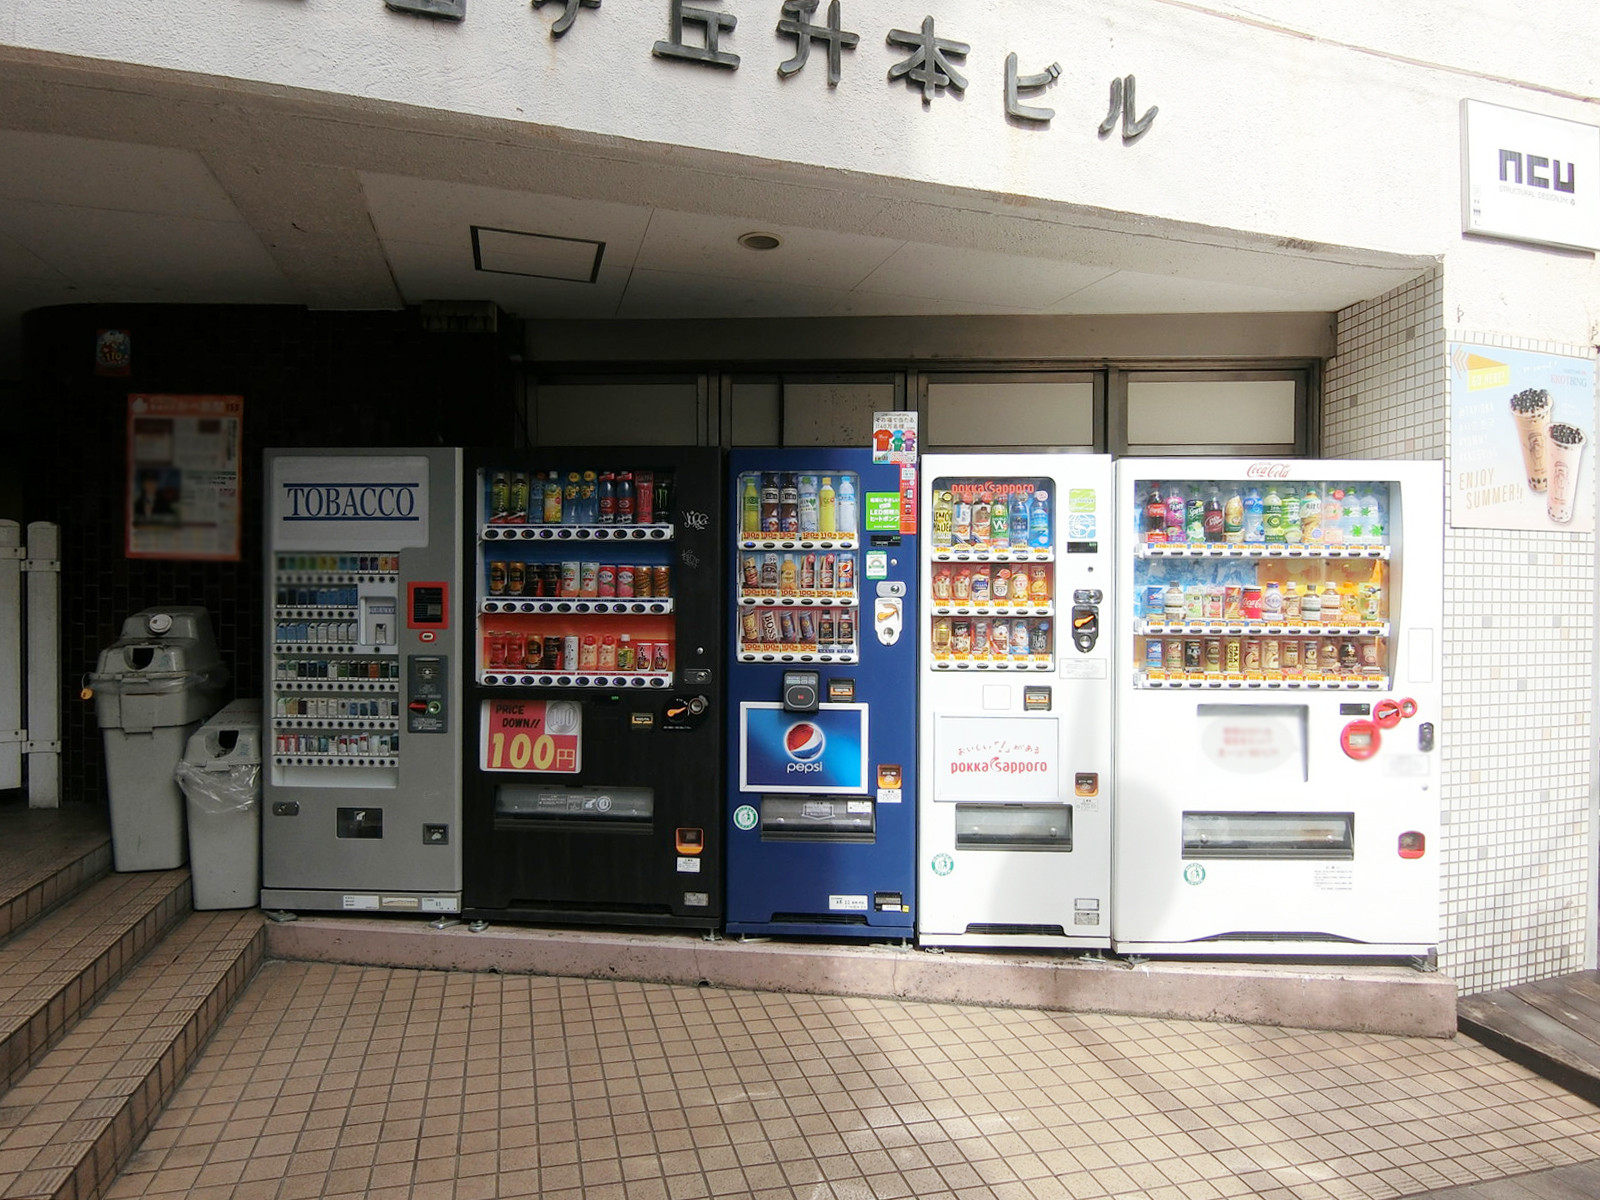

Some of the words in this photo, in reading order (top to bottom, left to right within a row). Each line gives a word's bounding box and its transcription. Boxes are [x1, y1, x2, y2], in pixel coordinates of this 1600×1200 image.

[1246, 463, 1292, 478] Coca-Cola
[1459, 467, 1495, 491] ENJOY
[287, 487, 414, 517] TOBACCO
[764, 615, 777, 641] BOSS
[495, 704, 526, 715] PRICE
[491, 732, 576, 770] 100円
[786, 761, 823, 774] pepsi
